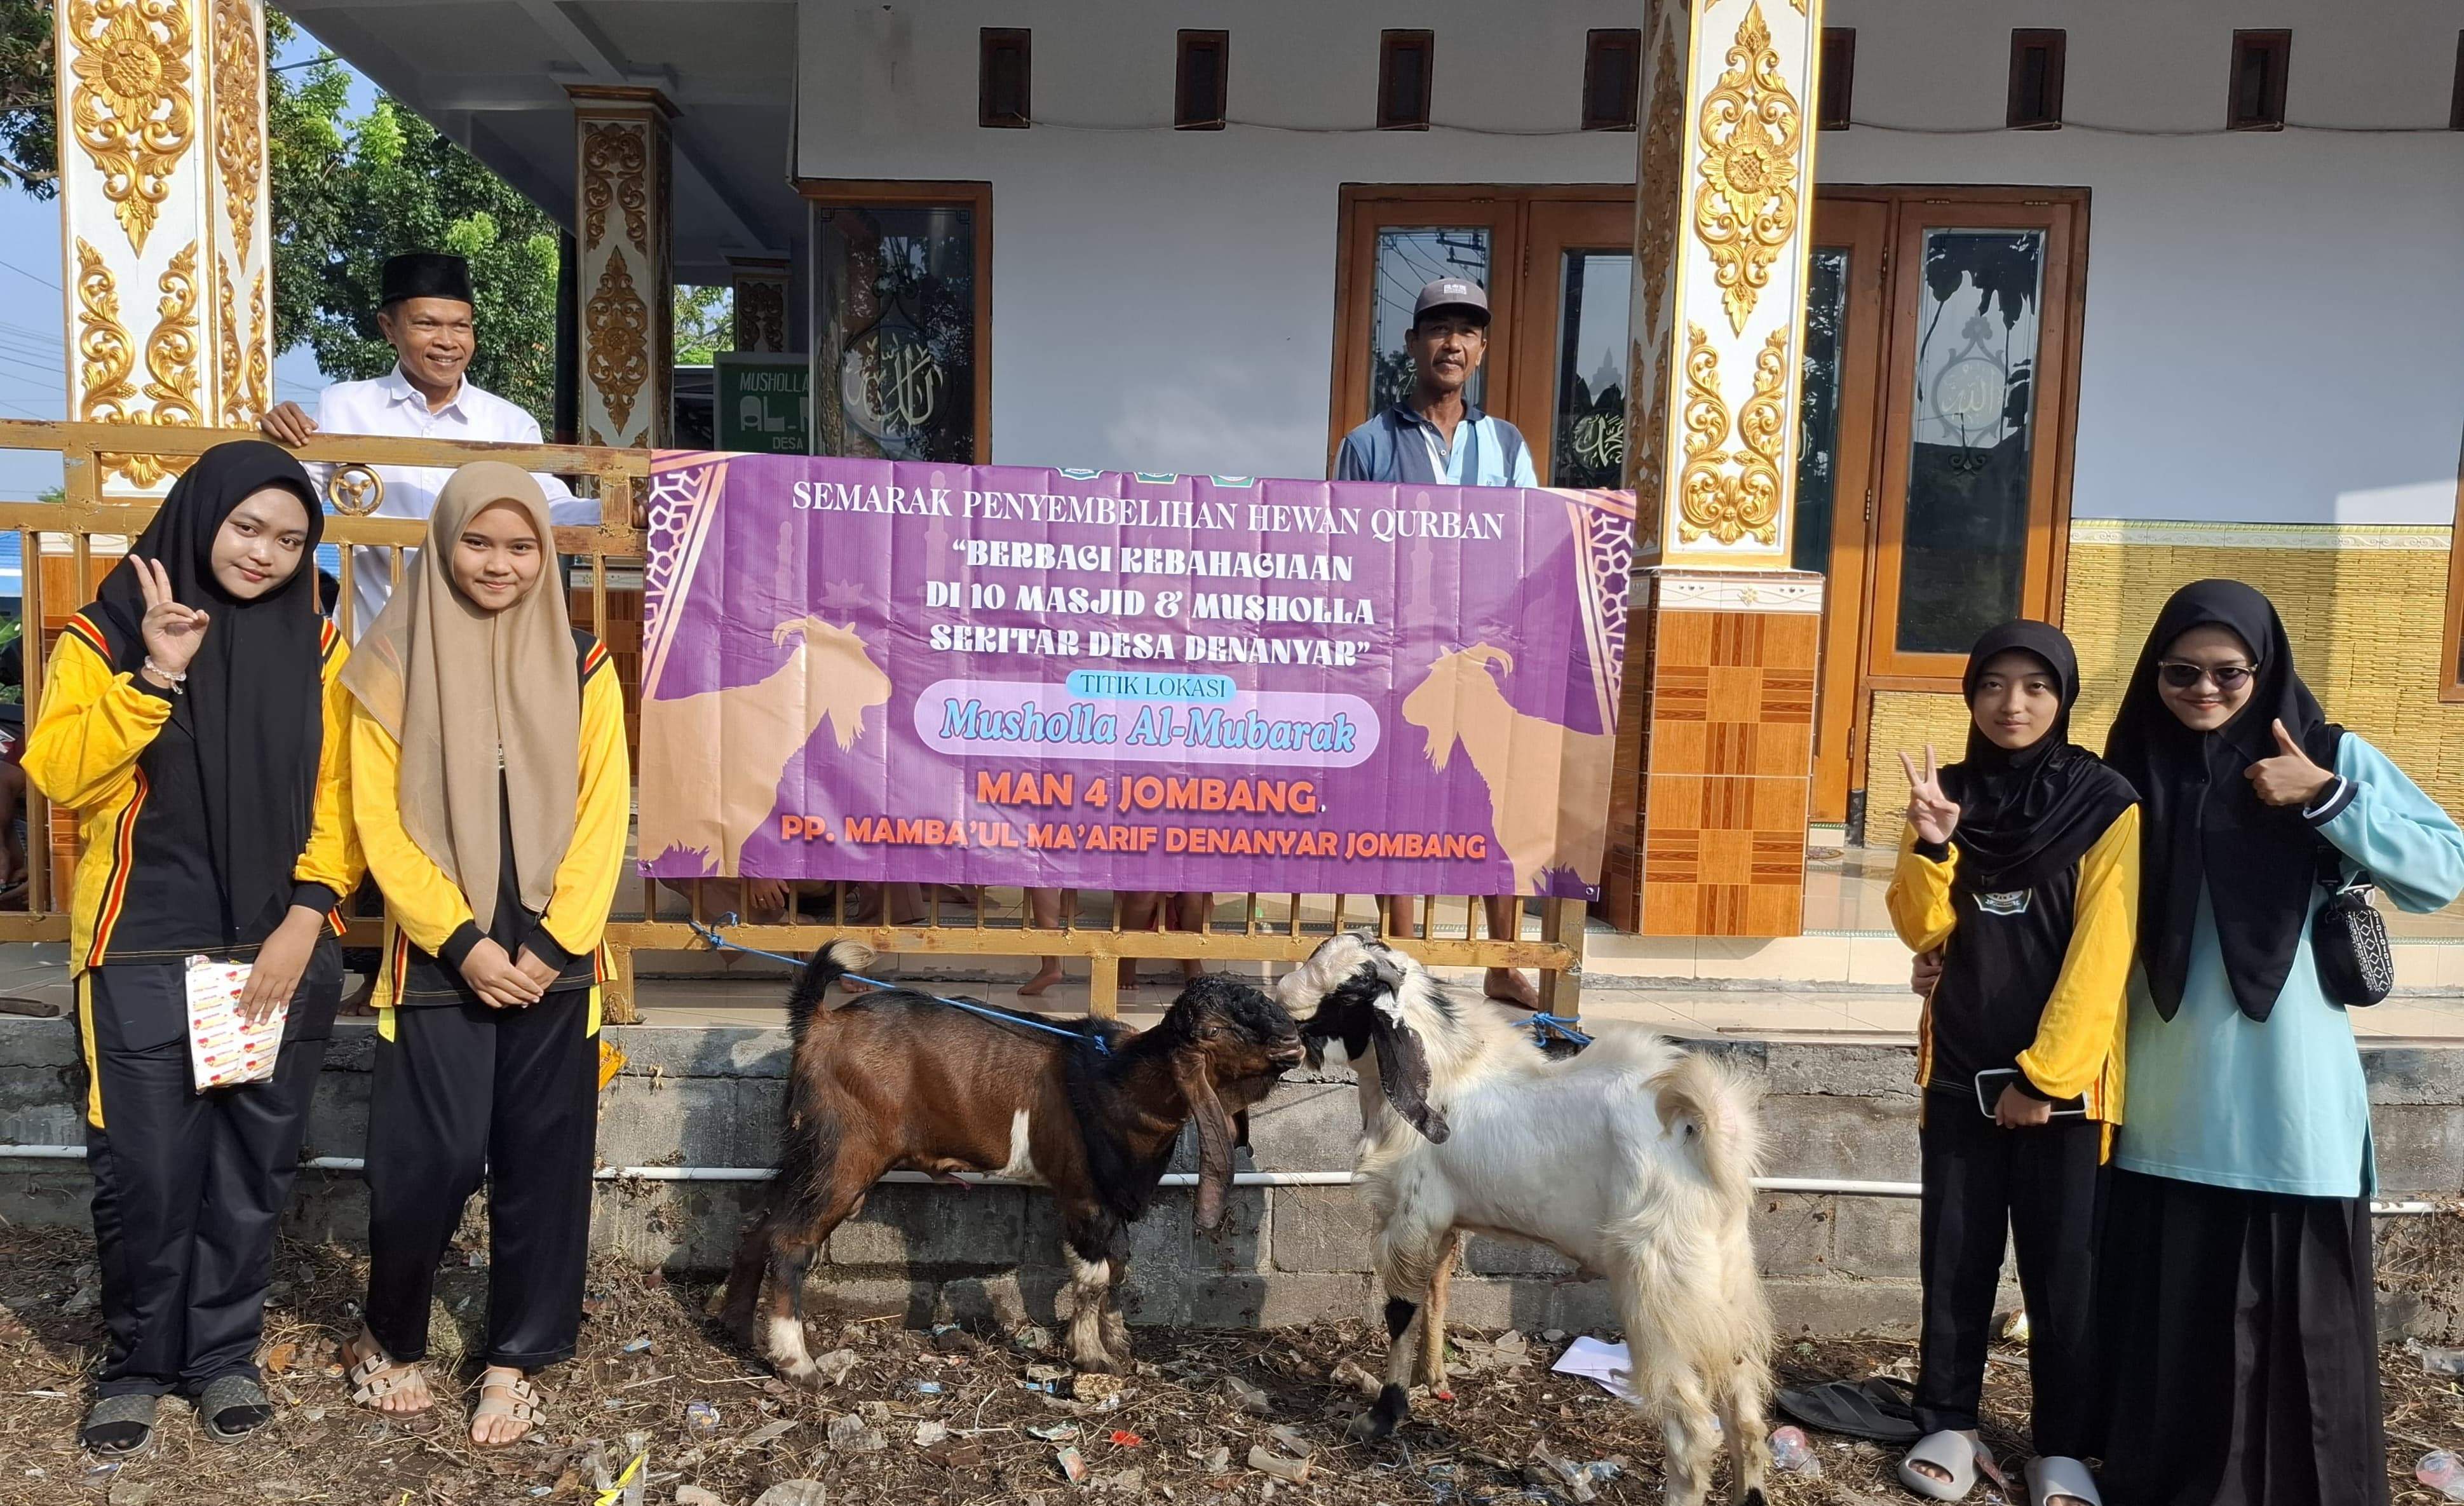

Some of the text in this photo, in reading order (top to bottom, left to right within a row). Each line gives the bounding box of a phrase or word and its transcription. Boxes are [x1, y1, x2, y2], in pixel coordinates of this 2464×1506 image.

[740, 372, 809, 392] MUSHOLLA
[773, 437, 804, 451] DESA
[792, 481, 1505, 542] SEMARAK PENYEMBELIHAN HEWAN QURBAN
[952, 538, 1353, 581] “BERBAGI KEBAHAGIAAN
[926, 580, 1376, 626] DI 10 MASJID & MUSHOLLA
[929, 624, 1371, 667] SEKITAR DESA DENANYAR”
[1080, 674, 1226, 698] TITIK LOKASI
[939, 697, 1357, 753] Musholla Al-Mubarak
[977, 771, 1316, 813] MAN 4 JOMBANG
[781, 815, 1486, 860] PP. MAMBA’UL MA’ARIF DENANYAR JOMBANG
